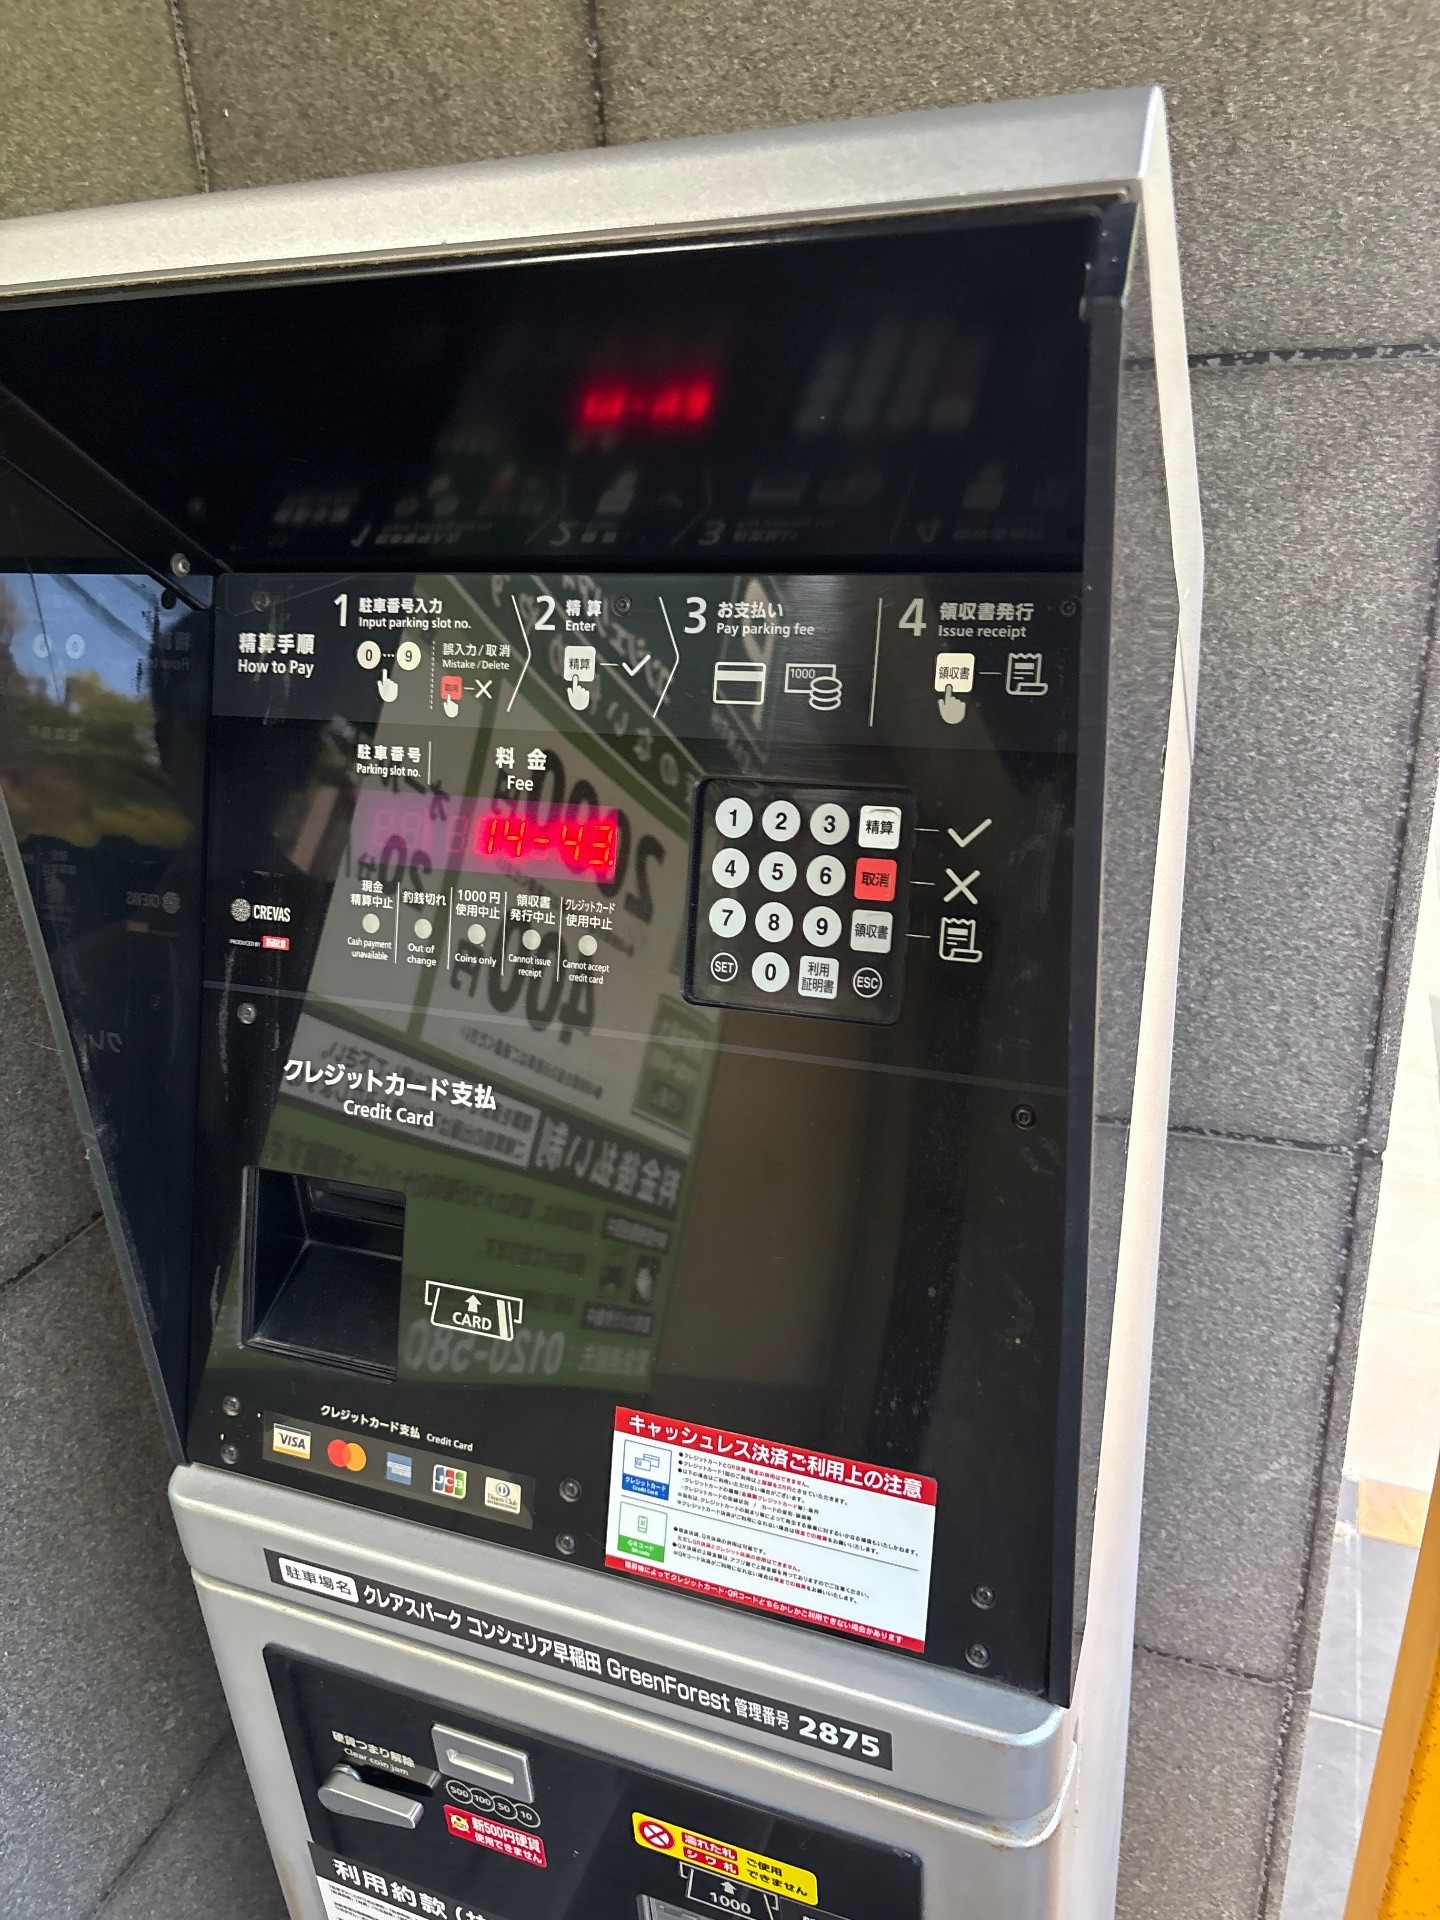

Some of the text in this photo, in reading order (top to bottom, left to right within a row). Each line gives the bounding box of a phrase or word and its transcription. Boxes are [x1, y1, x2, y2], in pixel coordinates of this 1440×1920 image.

[334, 594, 348, 627] 1
[359, 598, 443, 615] 駐車番号入力
[534, 595, 556, 631] 2
[566, 599, 602, 616] 精算
[717, 601, 784, 619] お支払い
[940, 601, 1034, 621] 領収書発行
[358, 617, 472, 631] Input parking slot no.
[684, 597, 707, 634] 3
[898, 598, 927, 637] 4
[566, 620, 596, 632] Enter
[716, 622, 815, 638] Pay parking fee
[938, 625, 1027, 640] Issue receipt
[238, 632, 316, 655] 精算手順
[238, 659, 314, 679] How to Pay
[568, 656, 591, 672] 精算
[790, 667, 816, 680] 1000
[938, 666, 970, 682] 領収書
[357, 744, 422, 763] 駐車番号
[495, 747, 548, 772] 料金
[356, 763, 421, 778] Parking slot no.
[507, 775, 534, 792] Fee
[729, 809, 738, 827] 1
[775, 812, 787, 831] 2
[824, 815, 836, 834] 3
[866, 819, 895, 836] 精算
[725, 860, 737, 877] 4
[772, 863, 784, 881] 5
[820, 866, 832, 885] 6
[361, 880, 384, 893] 現金
[861, 872, 890, 889] 取消
[350, 893, 394, 909] 精算中止
[402, 890, 447, 907] 釣銭切れ
[516, 894, 551, 909] 領収書
[564, 899, 616, 915] クレジットカード
[253, 904, 291, 923] CREVAS
[456, 903, 501, 920] 使用中止
[510, 908, 556, 925] 発行中止
[721, 909, 734, 927] 7
[565, 914, 613, 931] 使用中止
[768, 913, 780, 932] 8
[816, 917, 828, 936] 9
[854, 923, 889, 941] 領収書
[347, 937, 392, 949] Cash payment
[408, 943, 435, 955] Out of
[351, 951, 389, 961] unavailable
[407, 955, 437, 967] change
[454, 953, 497, 967] Coins only
[508, 954, 552, 967] Cannot issue
[518, 967, 542, 978] receipt
[562, 960, 610, 975] Cannot accept
[714, 960, 735, 973] SET
[765, 963, 777, 981] 0
[808, 961, 830, 978] 利用
[568, 973, 604, 985] credit card
[801, 977, 835, 995] 証明書
[856, 976, 879, 991] ESC
[283, 1059, 497, 1110] クレジットカード支払
[343, 1099, 434, 1128] Credit Card
[452, 1310, 493, 1332] CARD
[320, 1404, 474, 1452] クレジットカード支払 Credit Card
[278, 1432, 306, 1450] VISA
[628, 1414, 923, 1500] キャッシュレス決済ご利用上の注意
[435, 1474, 464, 1490] JCB
[624, 1476, 667, 1491] クレジットカード
[627, 1538, 655, 1552] QRコード
[285, 1563, 881, 1758] 駐車場名 クレアスパーク コンシェリア早稲田 GreenForest 管理番号 2875
[331, 1730, 415, 1768] 硬貨つまり解除
[344, 1748, 409, 1777] Clear coin jam
[450, 1785, 469, 1798] 500
[473, 1795, 492, 1806] 100
[497, 1803, 511, 1813] 50
[520, 1810, 533, 1821] 10
[471, 1817, 542, 1854] 新500円硬貨
[474, 1832, 543, 1864] 使用できません
[684, 1833, 736, 1860] 濡れた札
[746, 1856, 783, 1877] ご使用
[746, 1869, 808, 1897] できません
[709, 1891, 752, 1915] 1000
